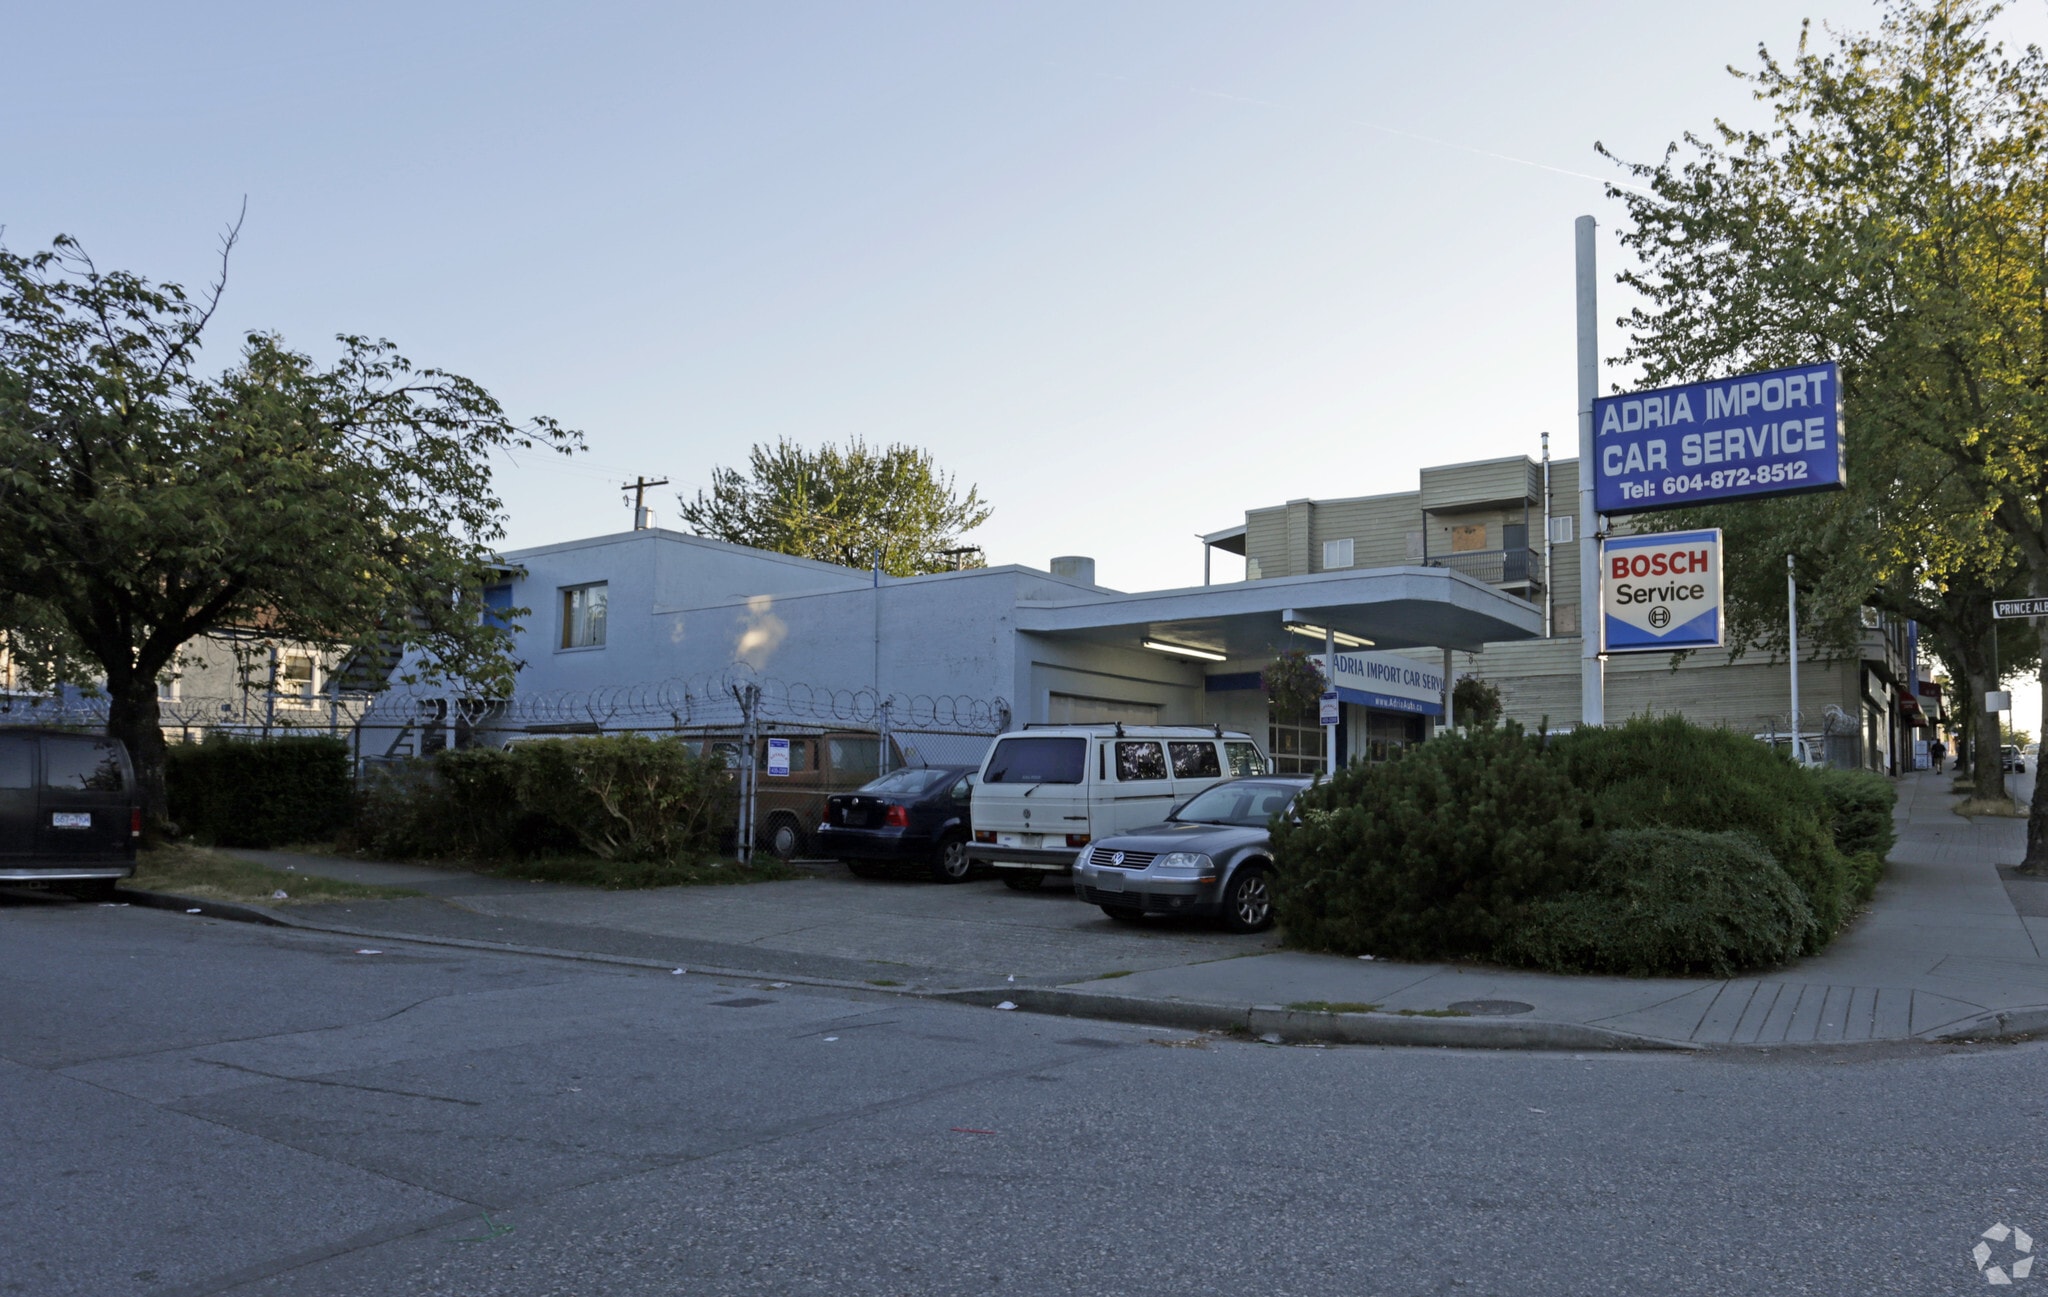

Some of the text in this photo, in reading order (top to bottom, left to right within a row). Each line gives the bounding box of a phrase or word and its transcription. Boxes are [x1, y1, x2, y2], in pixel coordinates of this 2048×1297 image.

[1600, 371, 1828, 436] ADRIA IMPORT
[1603, 417, 1826, 477] CAR SERVICE
[1620, 461, 1808, 500] Tel: 604-872-8512
[1612, 550, 1708, 579] BOSCH
[1616, 580, 1705, 605] Service
[2000, 603, 2031, 615] PRINCE
[1334, 654, 1364, 677] ADRIA
[1367, 661, 1401, 684] IMPORT
[1404, 669, 1421, 688] CAR
